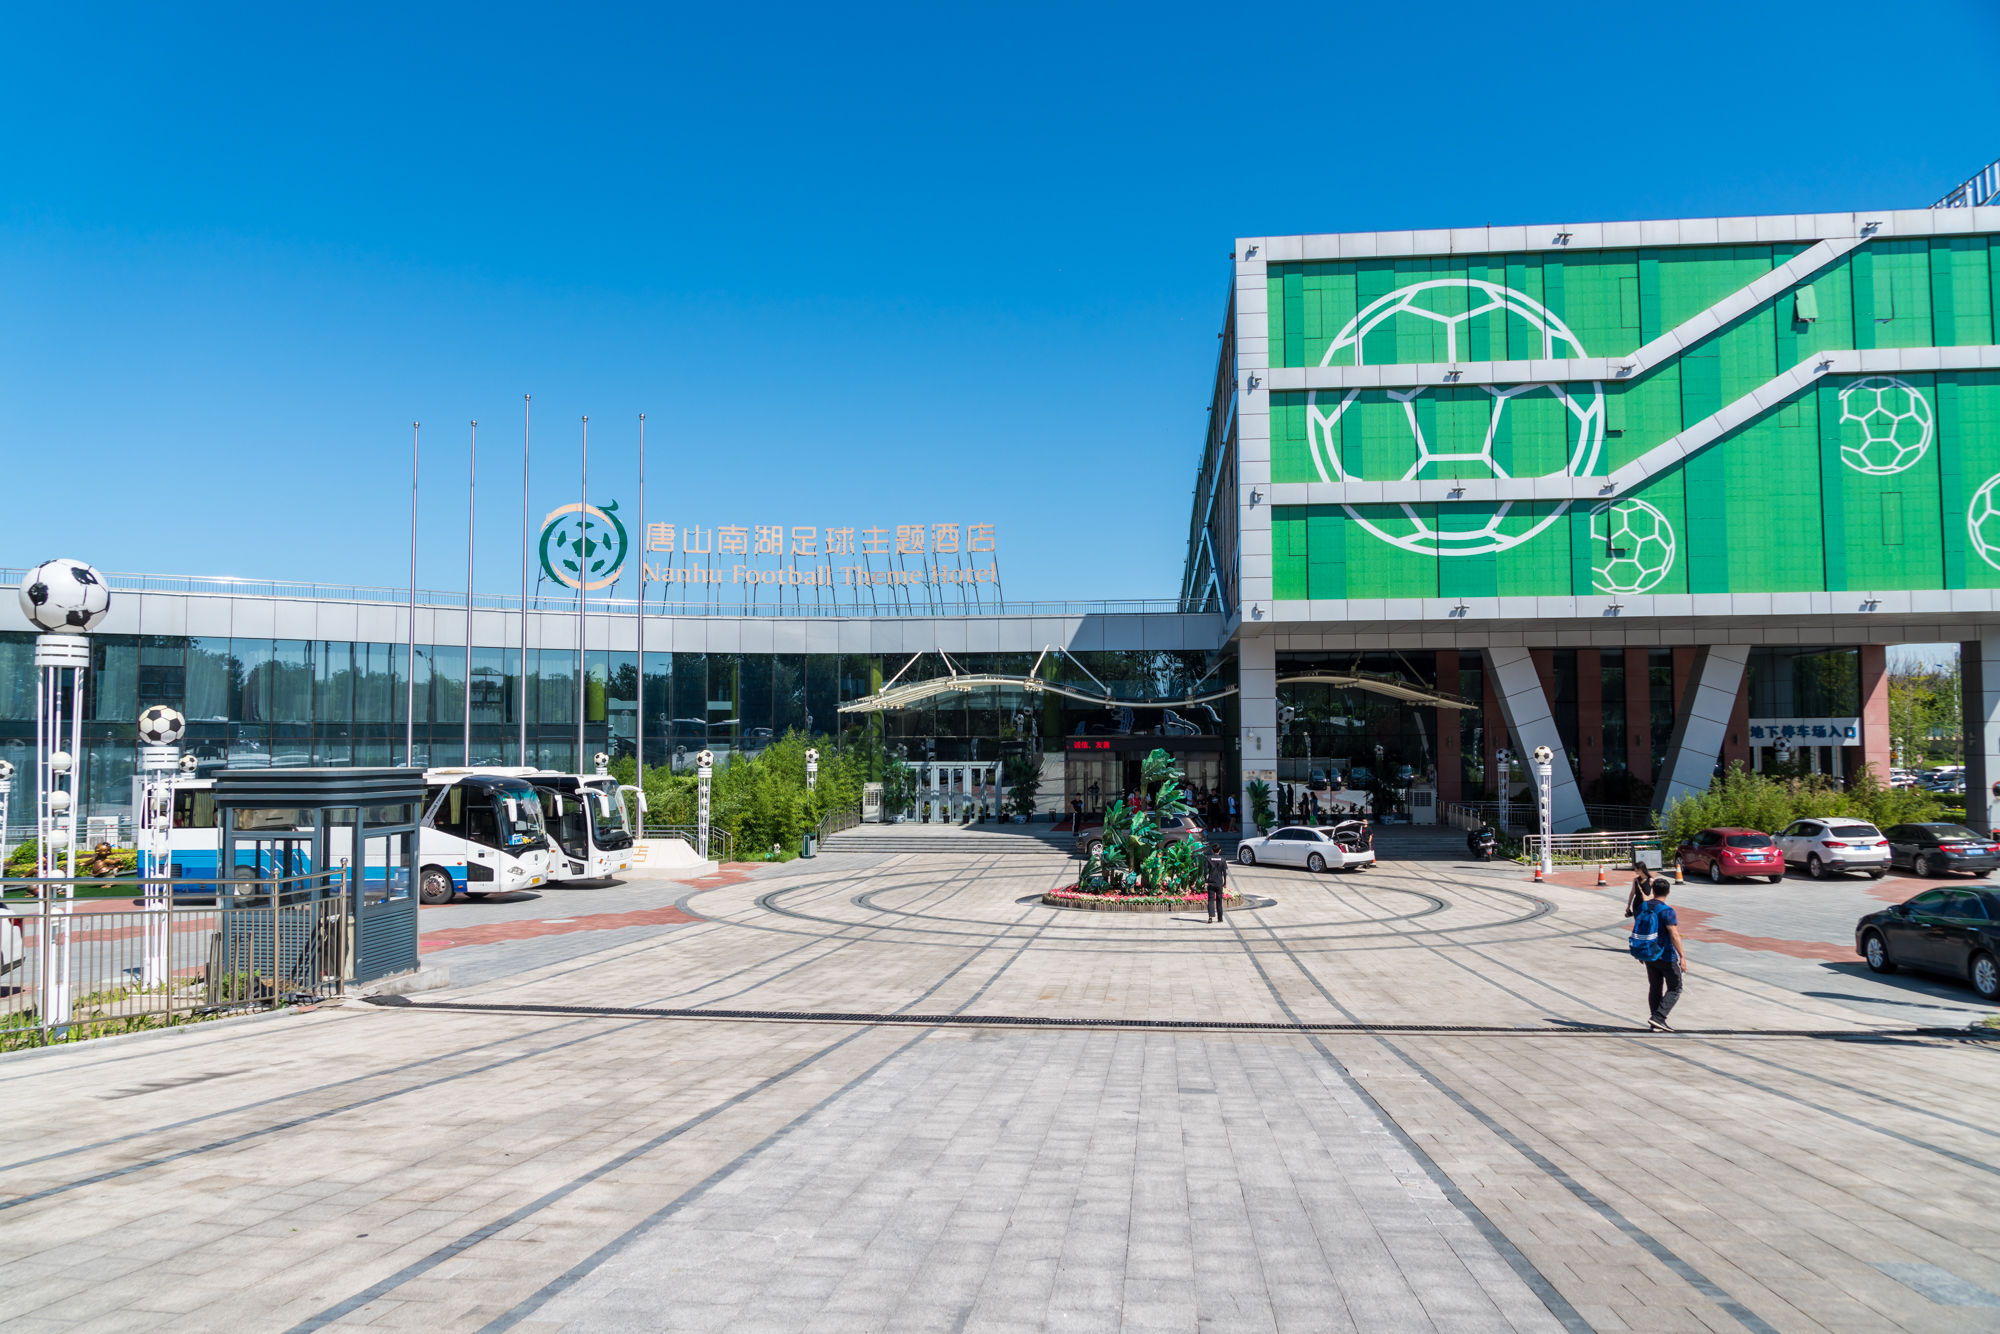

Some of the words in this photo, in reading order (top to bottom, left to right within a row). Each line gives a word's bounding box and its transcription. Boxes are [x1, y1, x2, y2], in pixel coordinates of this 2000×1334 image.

[646, 521, 996, 556] 唐山南湖足球主题酒店
[642, 562, 722, 584] Nanhu
[732, 564, 831, 586] Football
[840, 565, 923, 586] Theme
[931, 562, 997, 585] Hotel
[1750, 725, 1857, 739] 地下停车场入口
